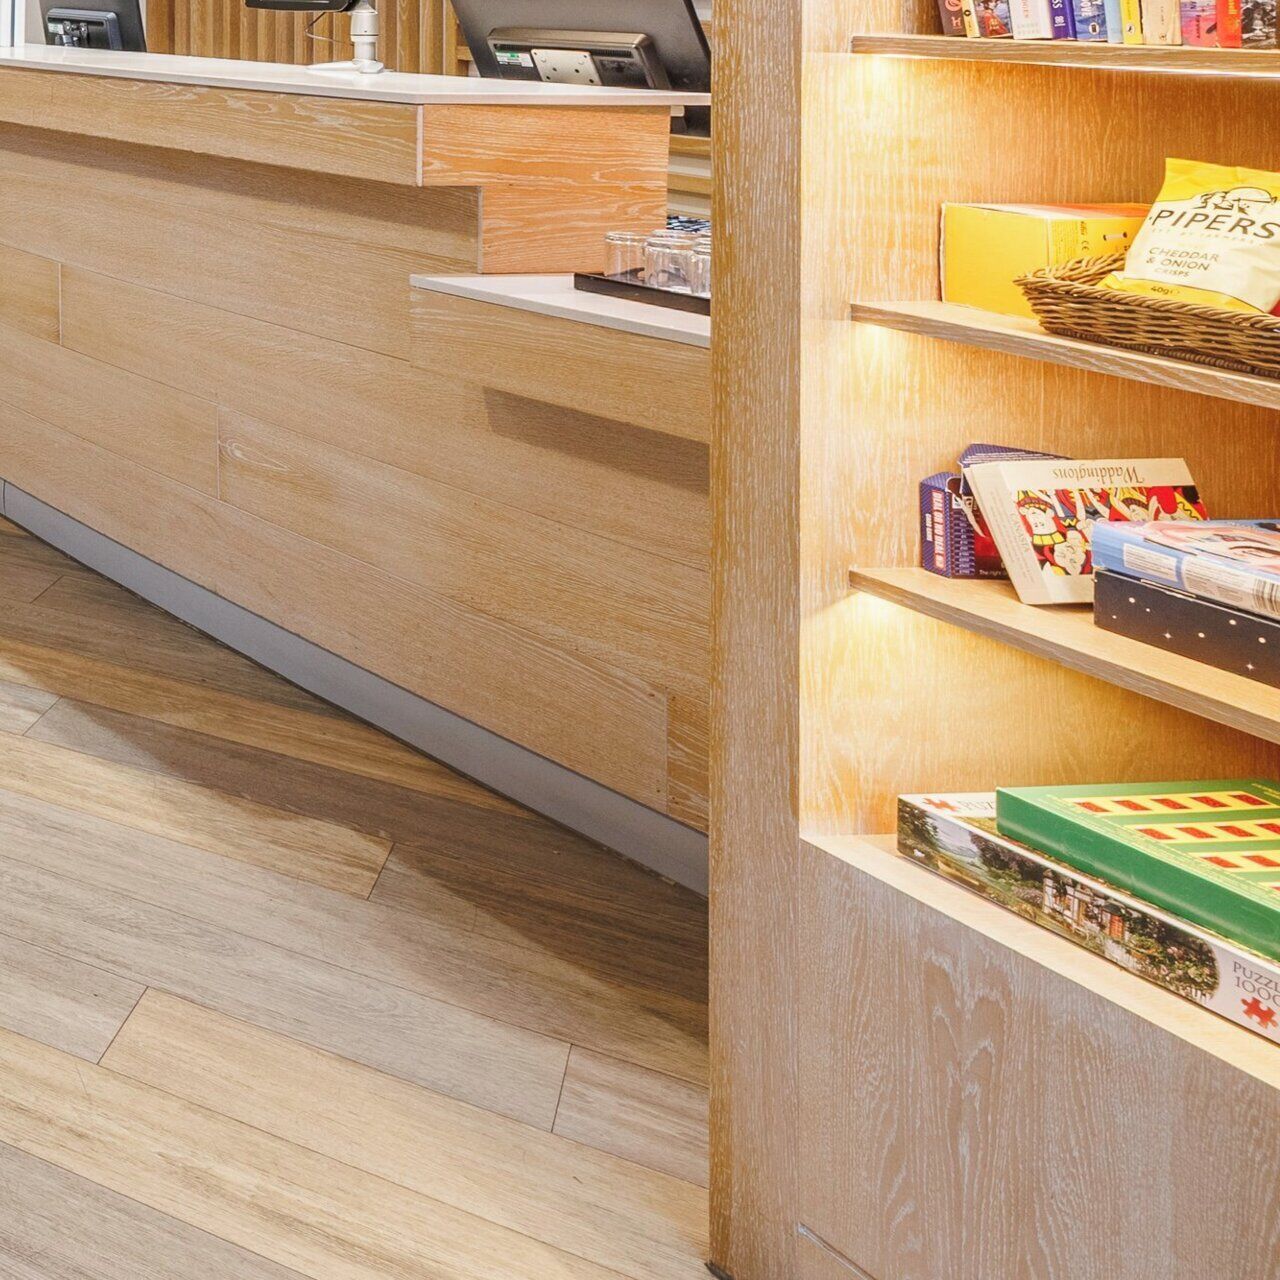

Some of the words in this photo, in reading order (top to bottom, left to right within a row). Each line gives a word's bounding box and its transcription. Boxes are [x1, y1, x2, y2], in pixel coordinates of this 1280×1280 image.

[1151, 209, 1280, 240] PIPERS
[1149, 247, 1219, 262] CHEDDAR
[1160, 258, 1210, 271] ONION
[1155, 268, 1190, 278] CRISPS
[1053, 466, 1146, 484] Waddingtons
[932, 492, 943, 511] DEAL
[934, 523, 944, 535] NO
[935, 535, 945, 554] DEAL
